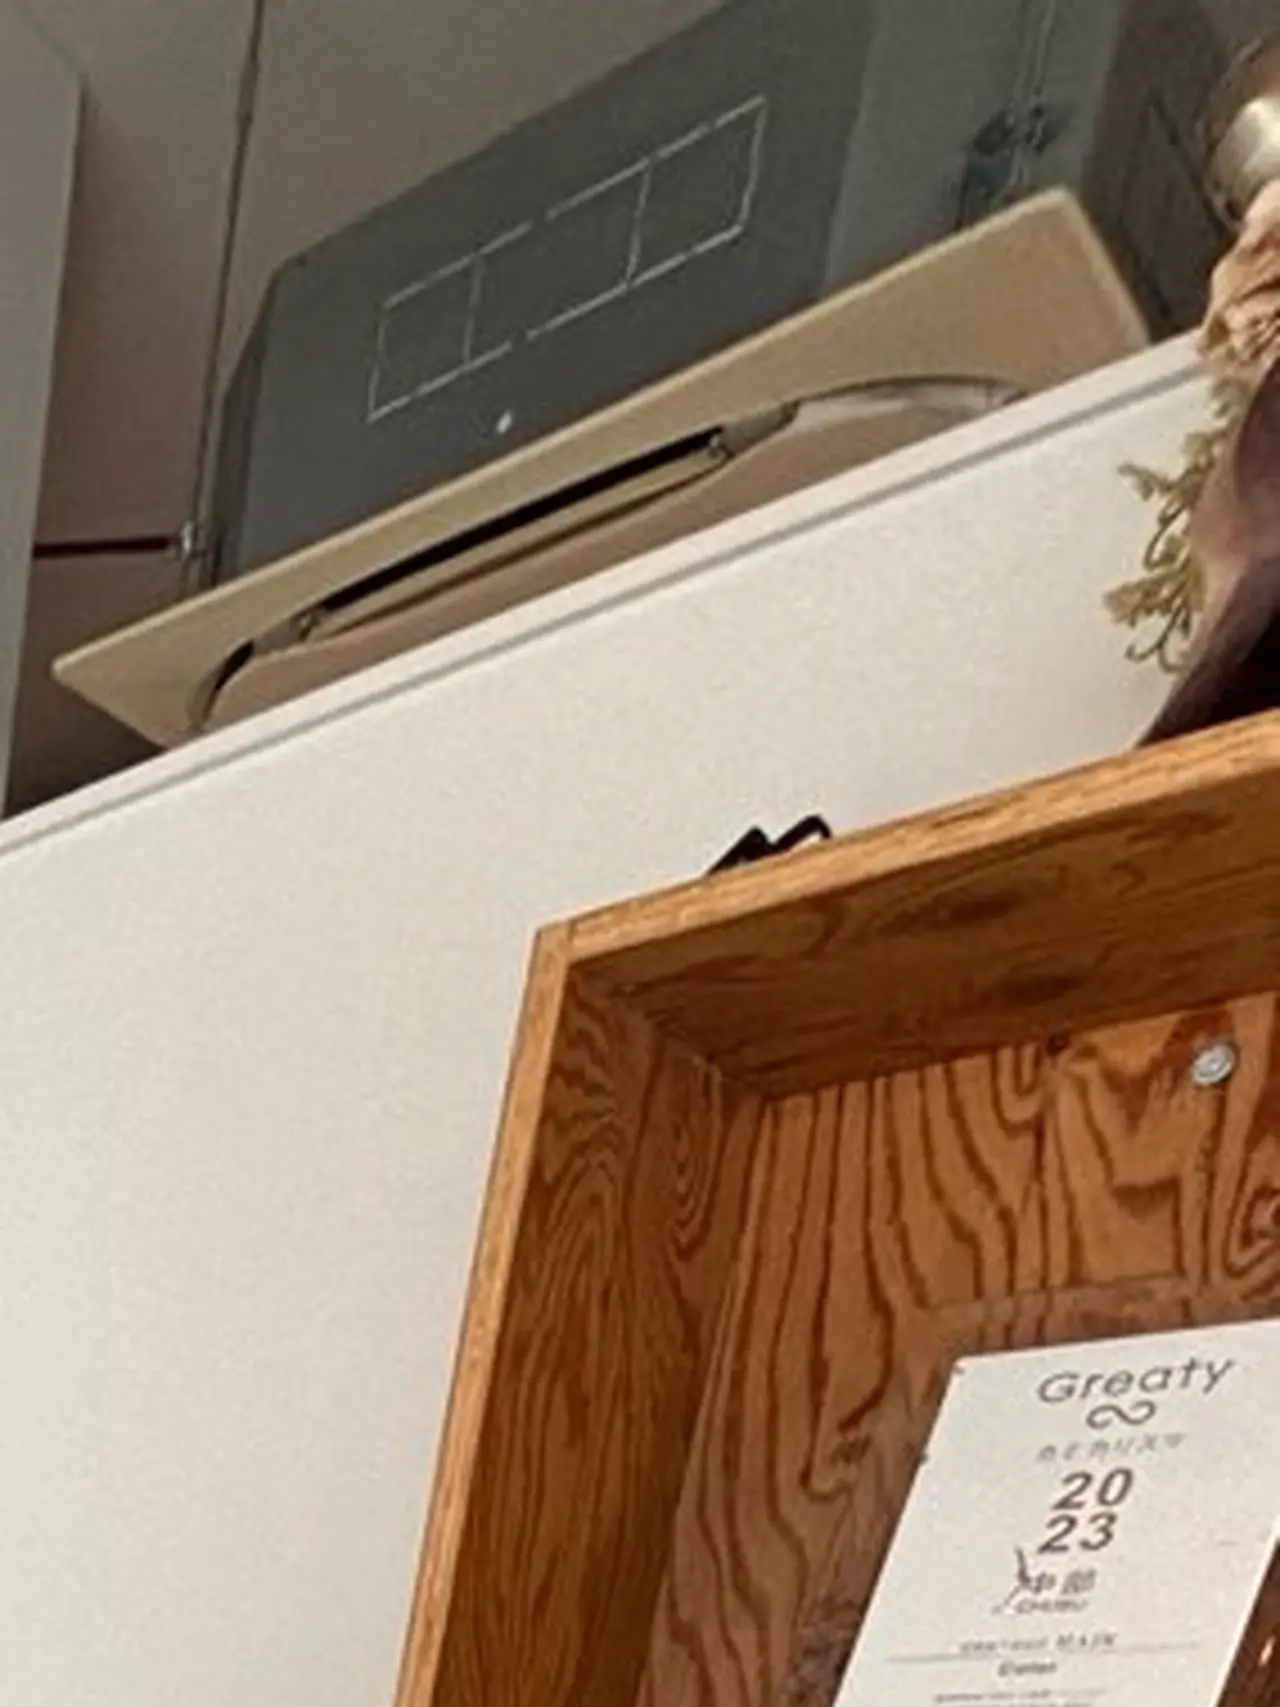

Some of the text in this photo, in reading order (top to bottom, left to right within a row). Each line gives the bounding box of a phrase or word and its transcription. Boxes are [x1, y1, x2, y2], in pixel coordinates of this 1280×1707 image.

[1037, 1357, 1233, 1403] Greaty
[1051, 1467, 1133, 1511] 20
[1037, 1513, 1117, 1555] 23
